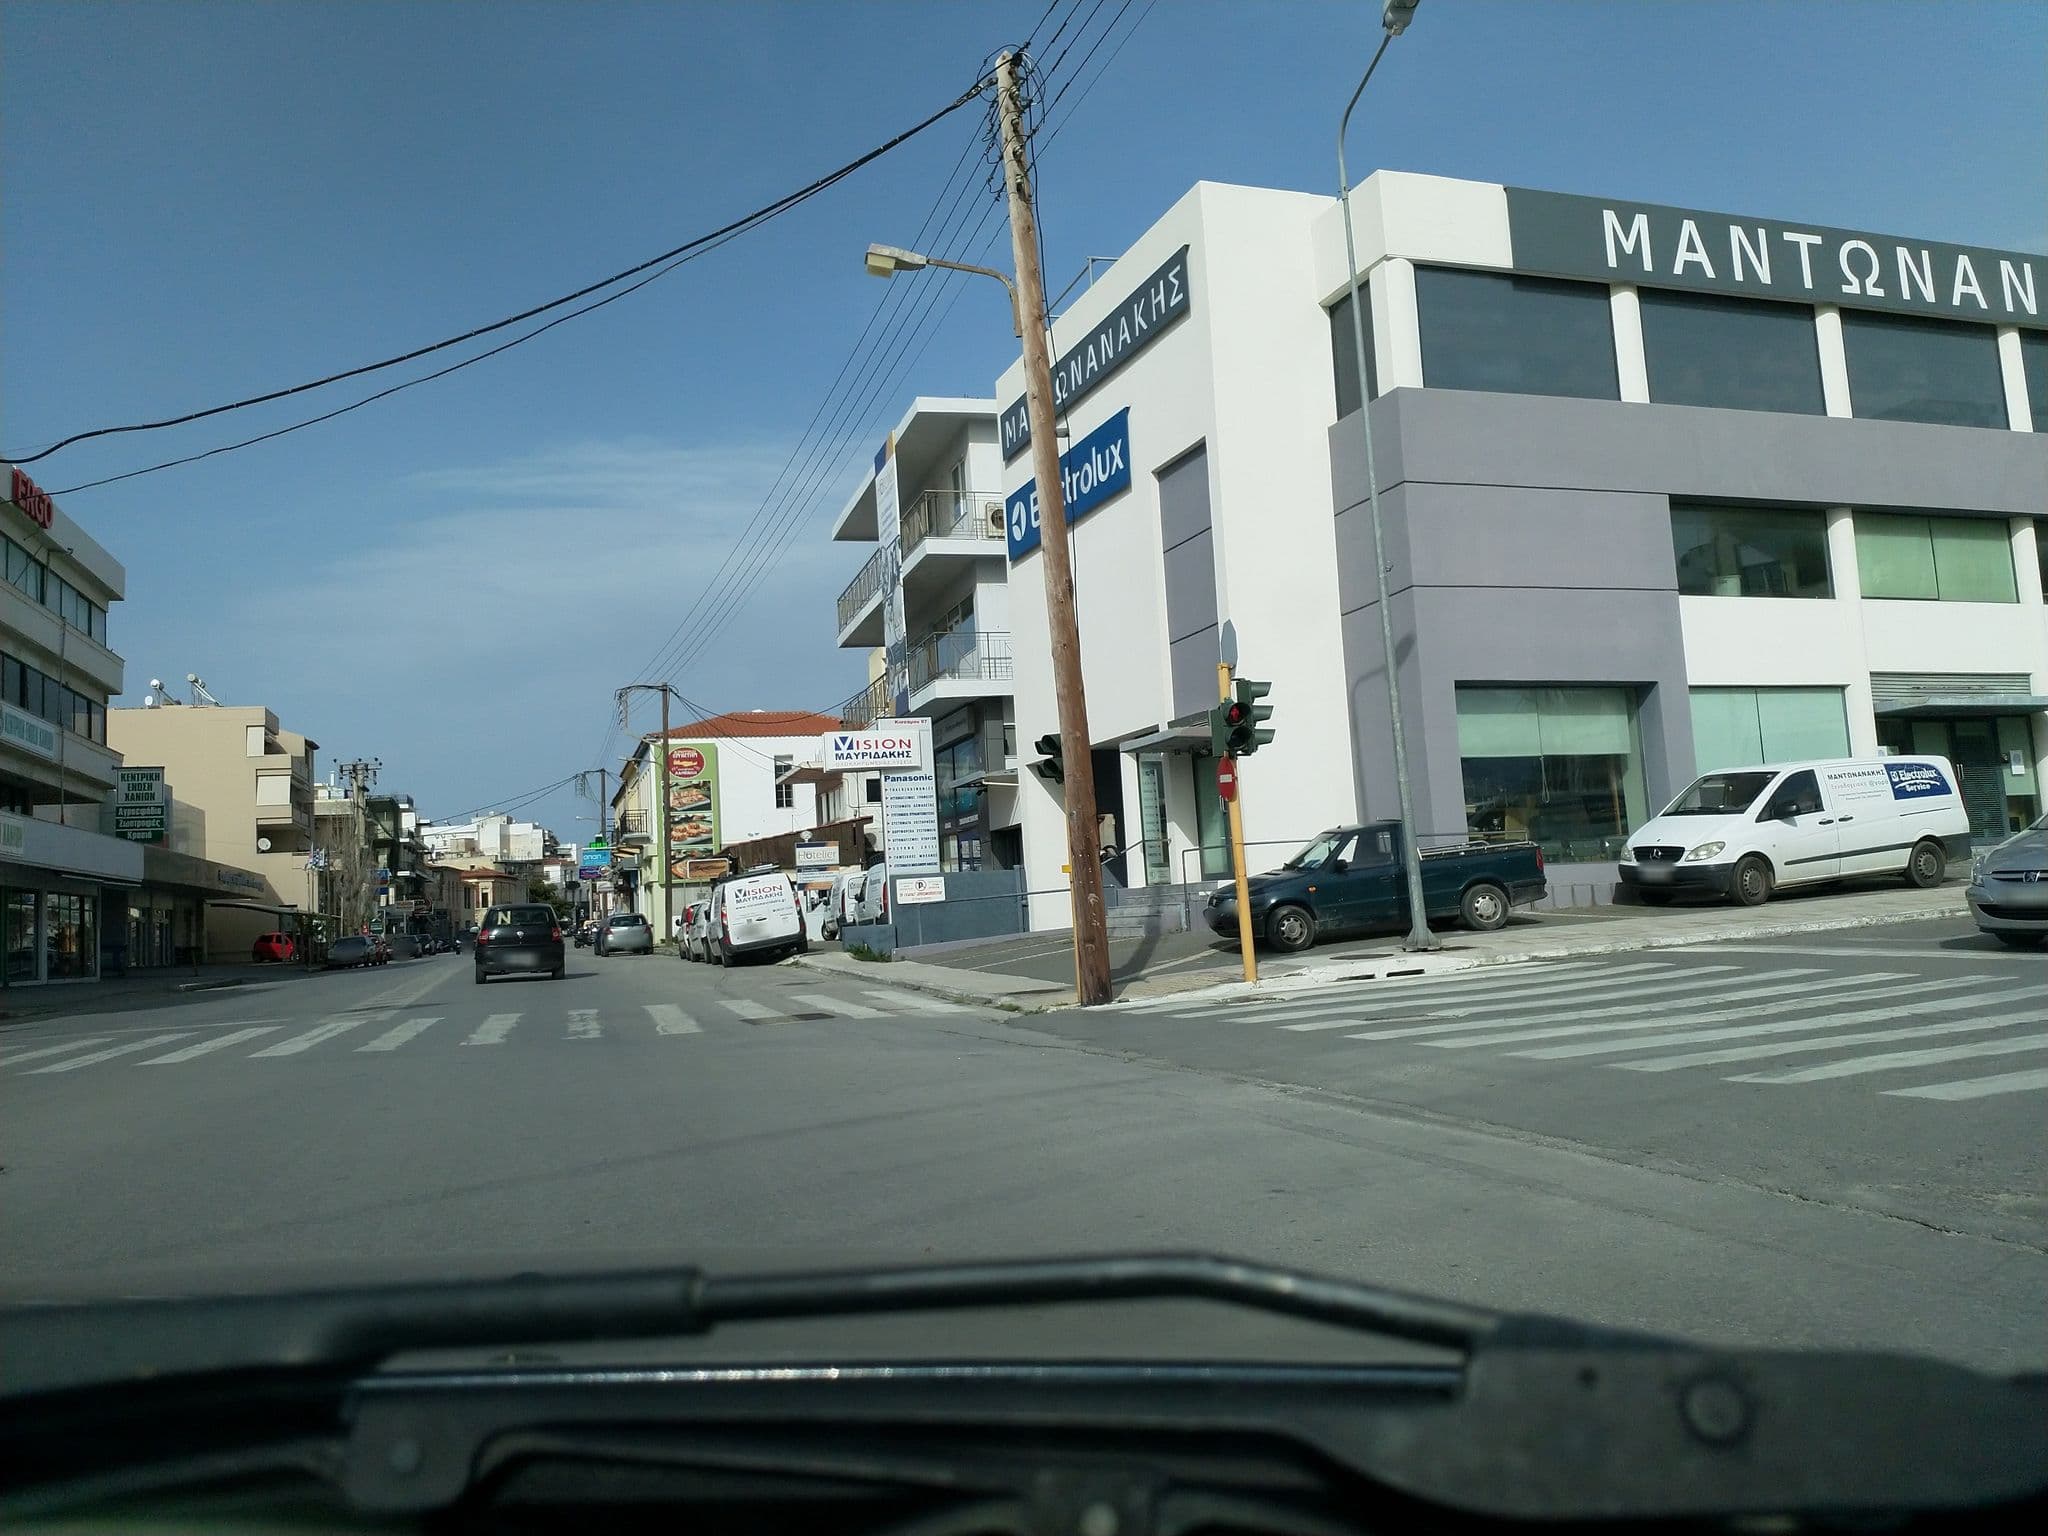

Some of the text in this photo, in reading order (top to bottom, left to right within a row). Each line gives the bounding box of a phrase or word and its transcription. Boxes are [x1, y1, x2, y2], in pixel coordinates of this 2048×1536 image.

[1602, 208, 2038, 315] ΜΑΝΤΩΝΑΝ
[1004, 263, 1185, 450] ΜΑΩΝΑΝΑΚΗΣ
[1029, 439, 1126, 530] Etrolux
[12, 468, 54, 529] ERGO
[834, 736, 912, 751] VISION
[835, 750, 912, 761] ΜΑΥΡΙΔΑΚΗΣ
[120, 772, 160, 782] ΚΕΝΤΡΙΚΗ
[884, 773, 933, 783] Panasonic
[1827, 769, 1885, 780] ΜΑΝΤΩΝΑΝΑΚΗΣ
[1899, 767, 1938, 781] Electrolux
[127, 782, 153, 792] ΕΝΩΣΗ
[1905, 783, 1931, 792] Service
[124, 792, 156, 802] ΧΑΝΙΩΝ
[734, 885, 783, 899] VISION
[496, 910, 512, 926] N
